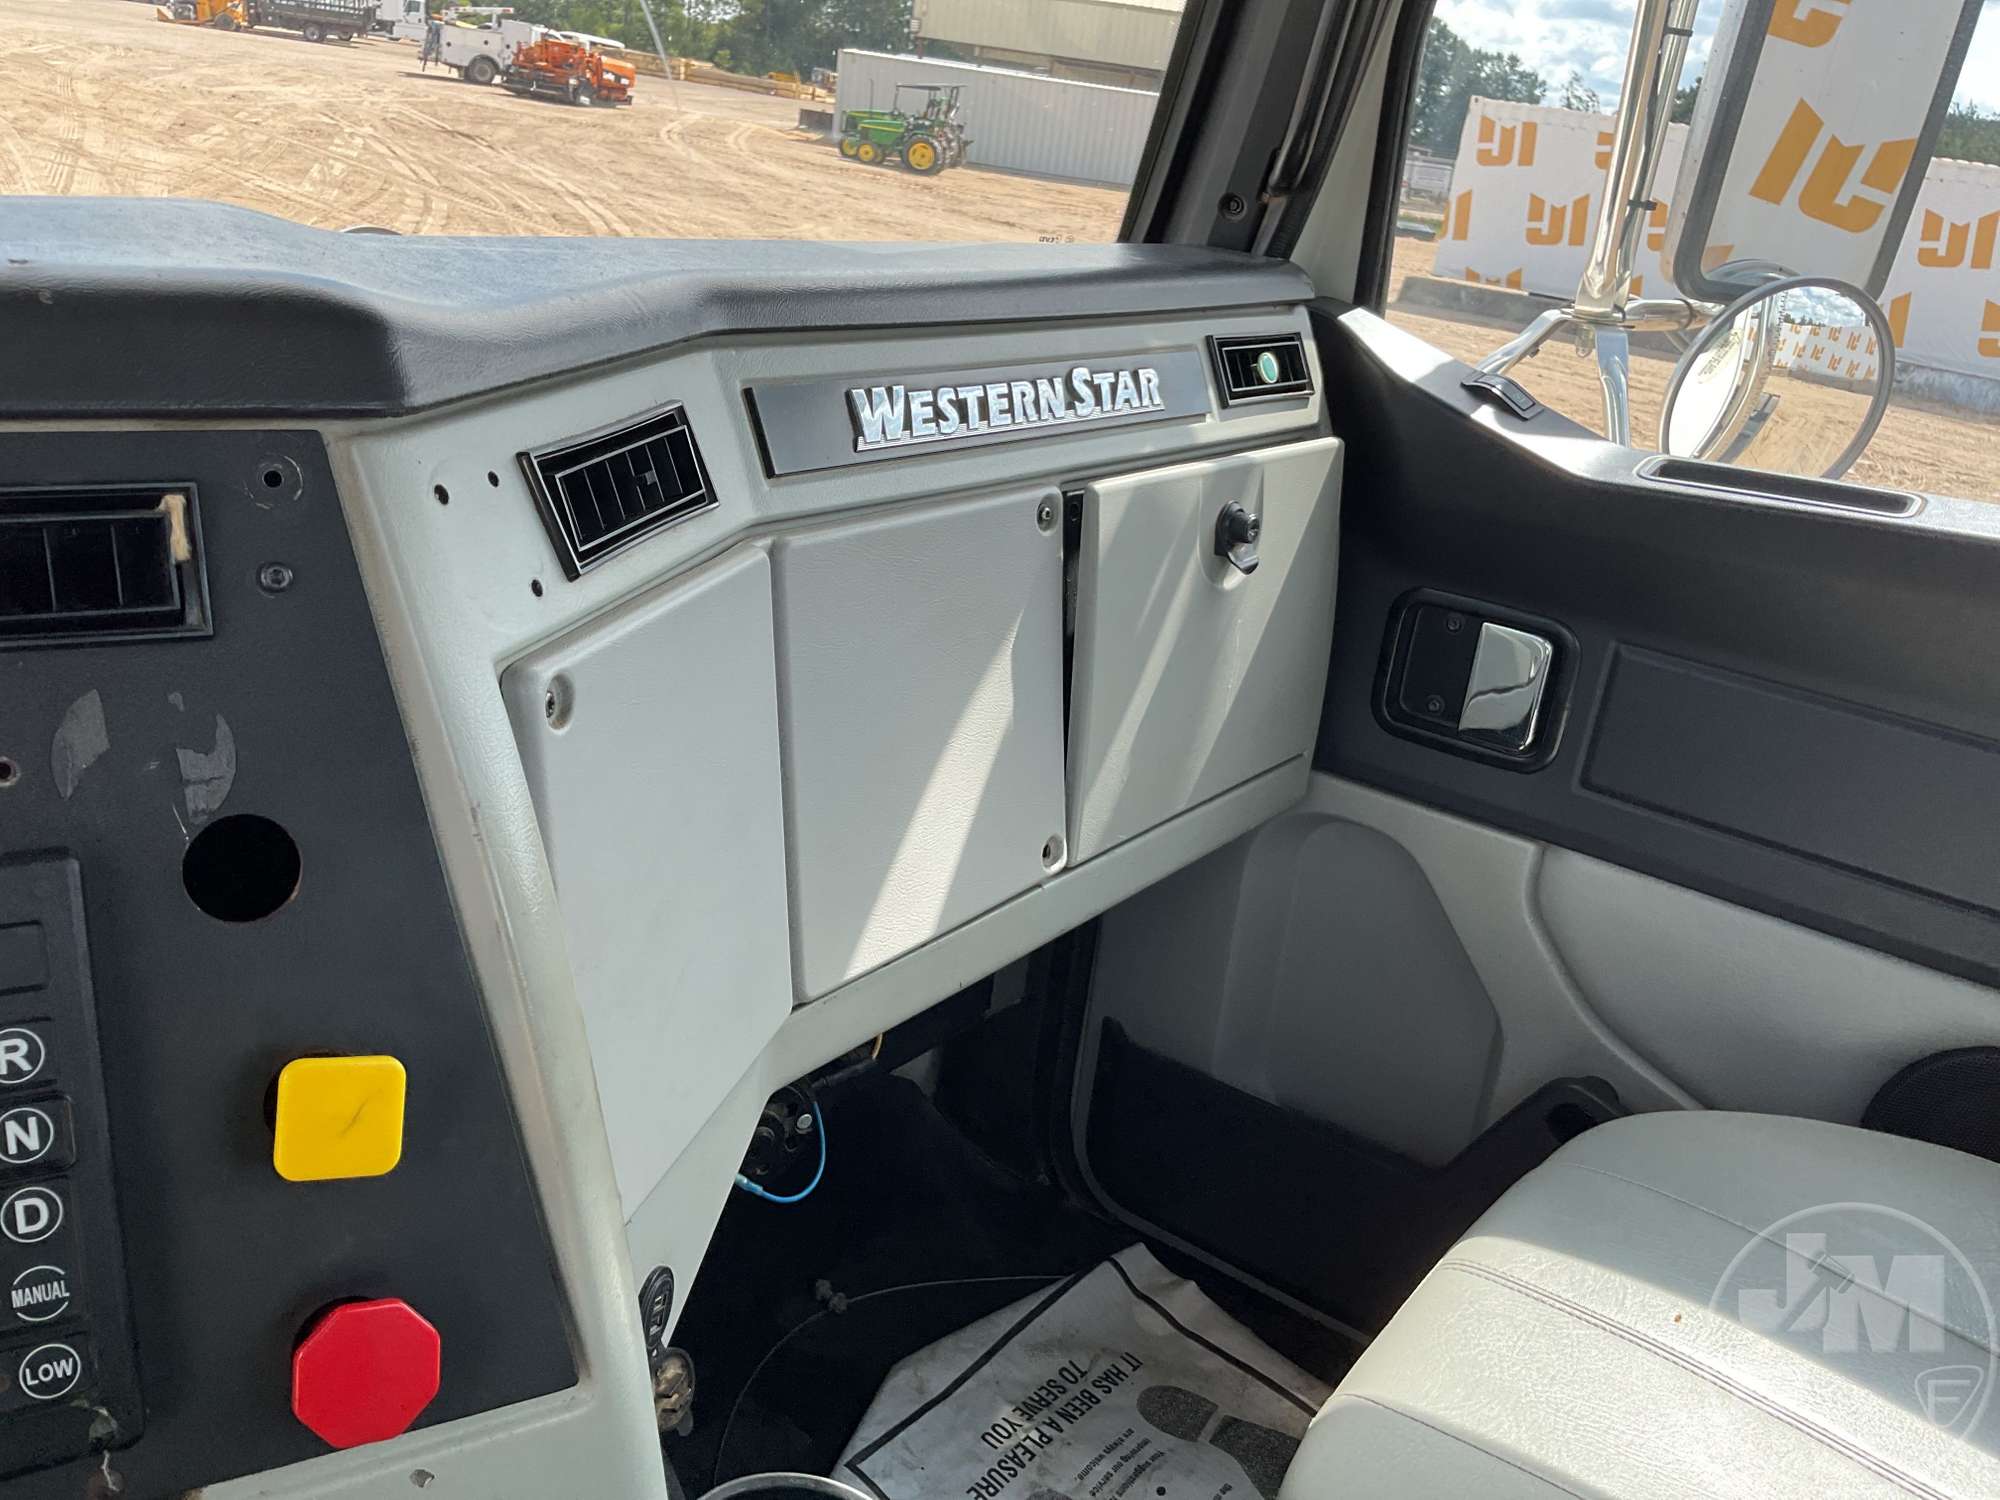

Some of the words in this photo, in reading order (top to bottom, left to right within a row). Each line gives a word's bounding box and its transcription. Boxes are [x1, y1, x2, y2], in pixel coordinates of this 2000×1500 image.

[849, 378, 1066, 444] WESTERN
[1071, 366, 1164, 419] STAR
[0, 1038, 33, 1075] R
[4, 1116, 40, 1155] N
[14, 1198, 48, 1234] D
[11, 1279, 70, 1309] MANUAL
[25, 1358, 75, 1386] LOW
[1058, 1360, 1089, 1384] TO
[1091, 1363, 1129, 1395] HAS
[1120, 1352, 1144, 1372] IT
[1011, 1379, 1067, 1422] SERVE
[1055, 1388, 1102, 1425] BEEN
[980, 1416, 1024, 1450] YOU
[1041, 1416, 1064, 1434] A
[966, 1426, 1054, 1500] PLEASURE
